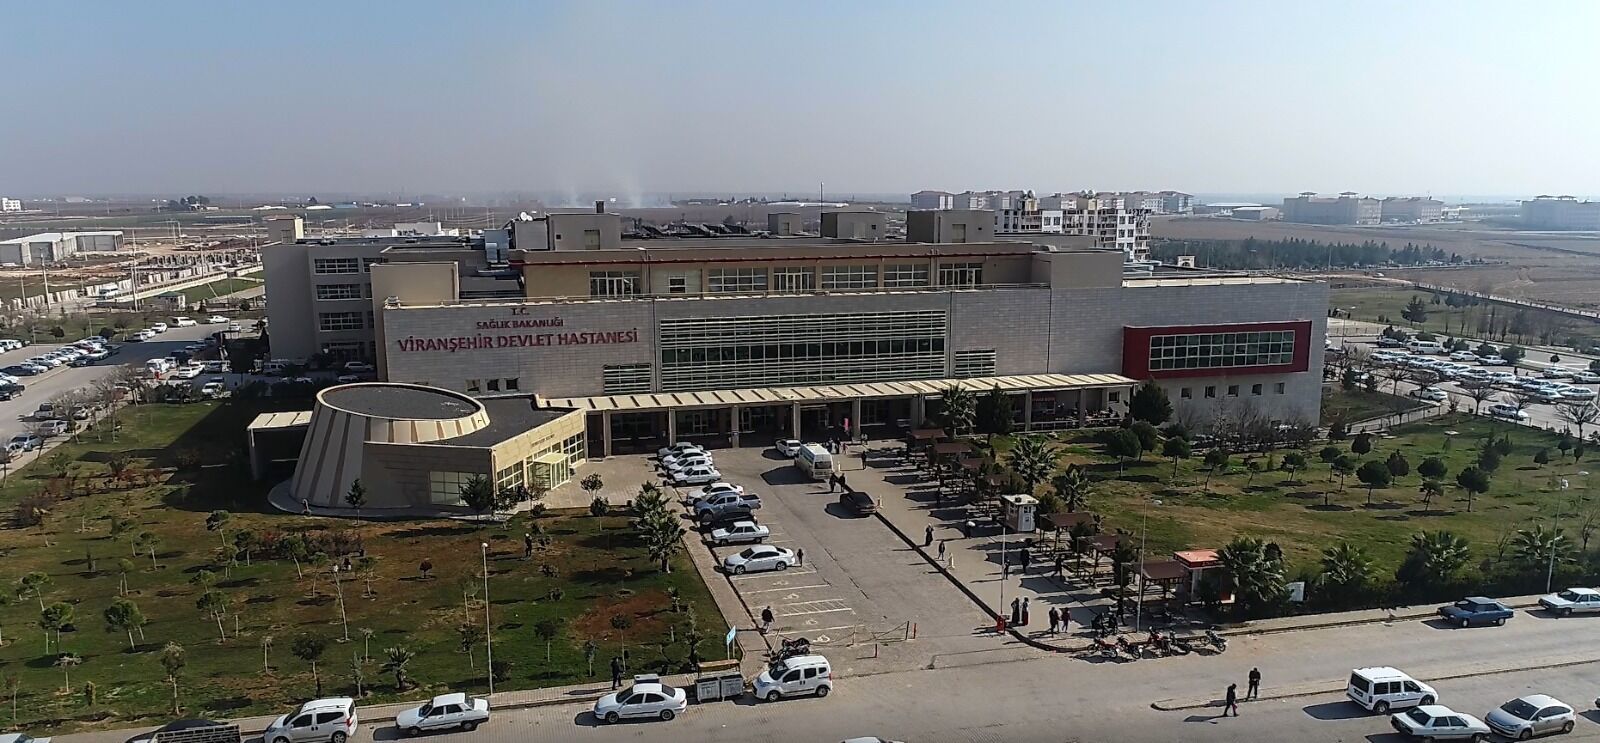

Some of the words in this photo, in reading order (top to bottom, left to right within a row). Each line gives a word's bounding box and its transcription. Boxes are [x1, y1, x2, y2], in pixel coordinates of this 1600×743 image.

[476, 318, 511, 330] SAĞLIK
[513, 316, 564, 329] BAKANLIĞI
[397, 333, 494, 353] VİRANŞEHİR
[496, 333, 554, 349] DEVLET
[557, 327, 638, 346] HASTANESİ
